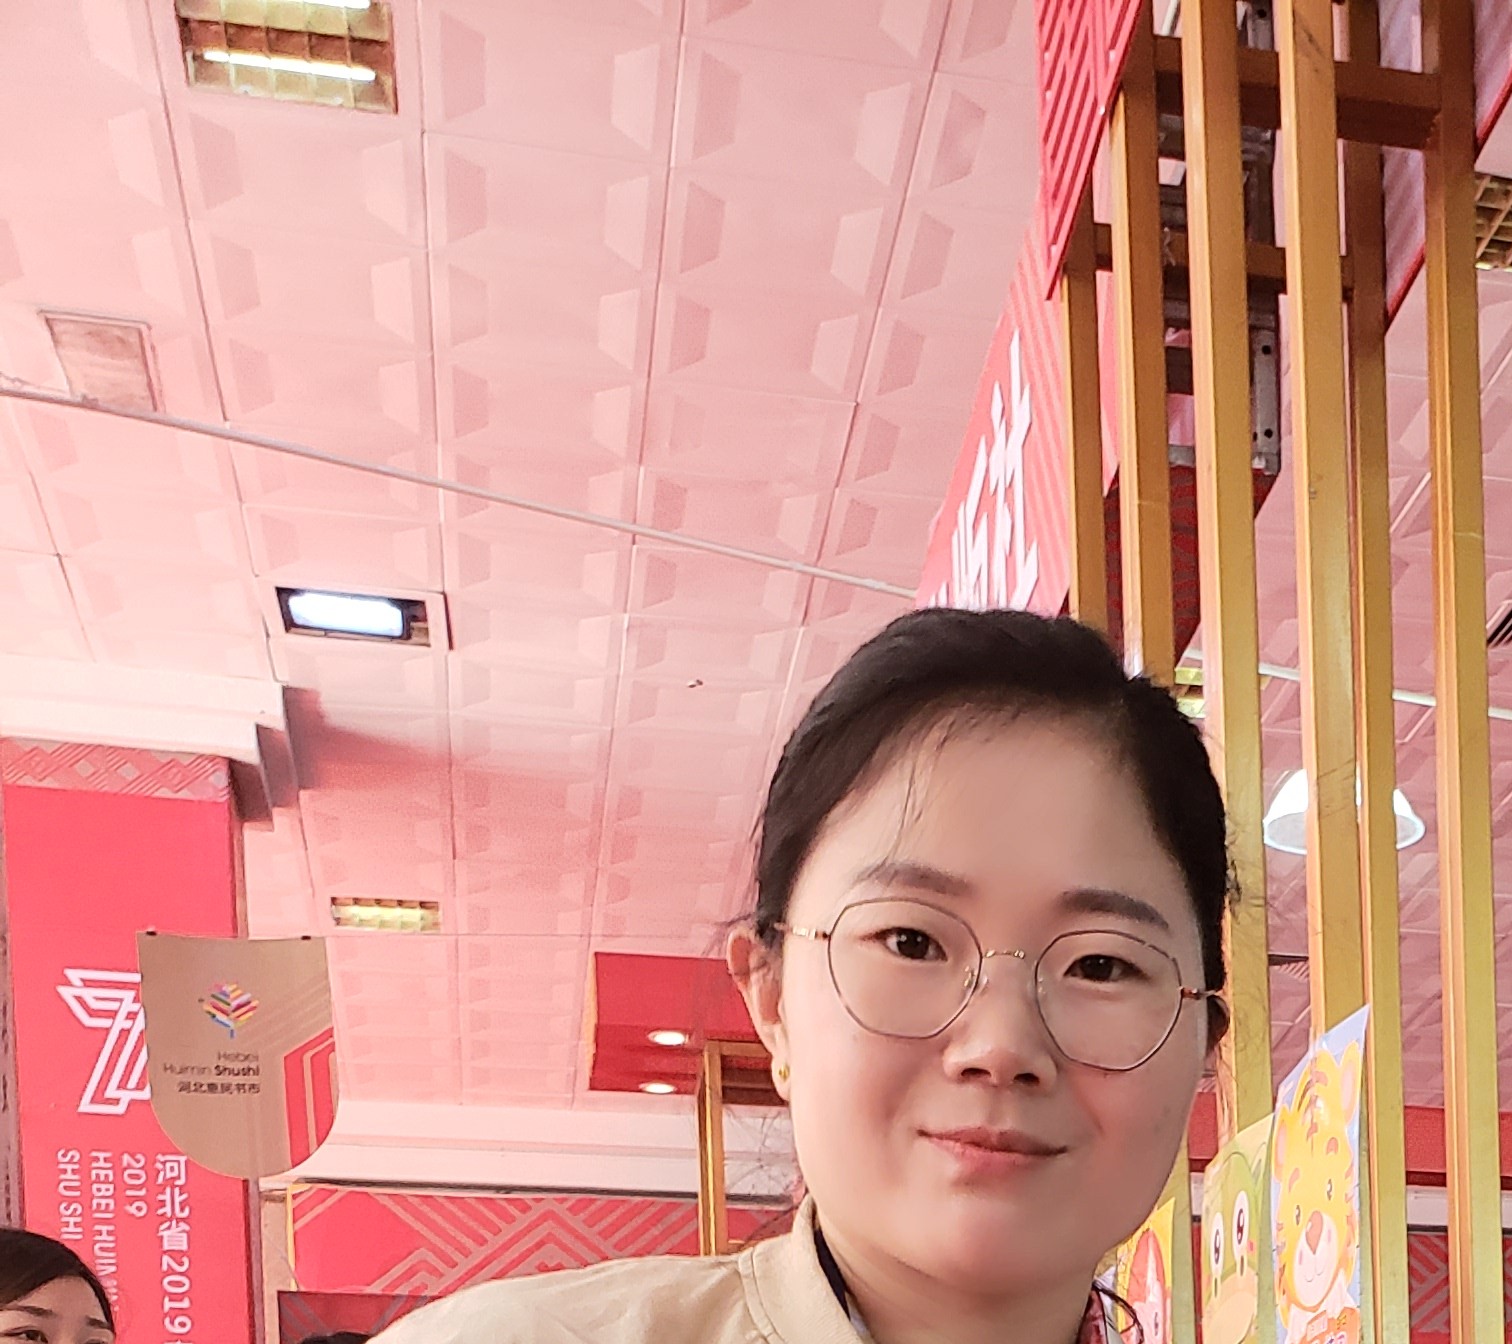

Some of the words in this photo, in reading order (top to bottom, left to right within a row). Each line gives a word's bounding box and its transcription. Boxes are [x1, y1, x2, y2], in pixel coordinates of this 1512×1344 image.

[177, 1081, 260, 1094] 河北惠民书市
[214, 1064, 260, 1076] Shushi
[57, 1149, 81, 1197] SHU
[90, 1152, 116, 1218] HEBEI
[121, 1153, 148, 1217] 2019
[60, 1203, 83, 1240] SHI
